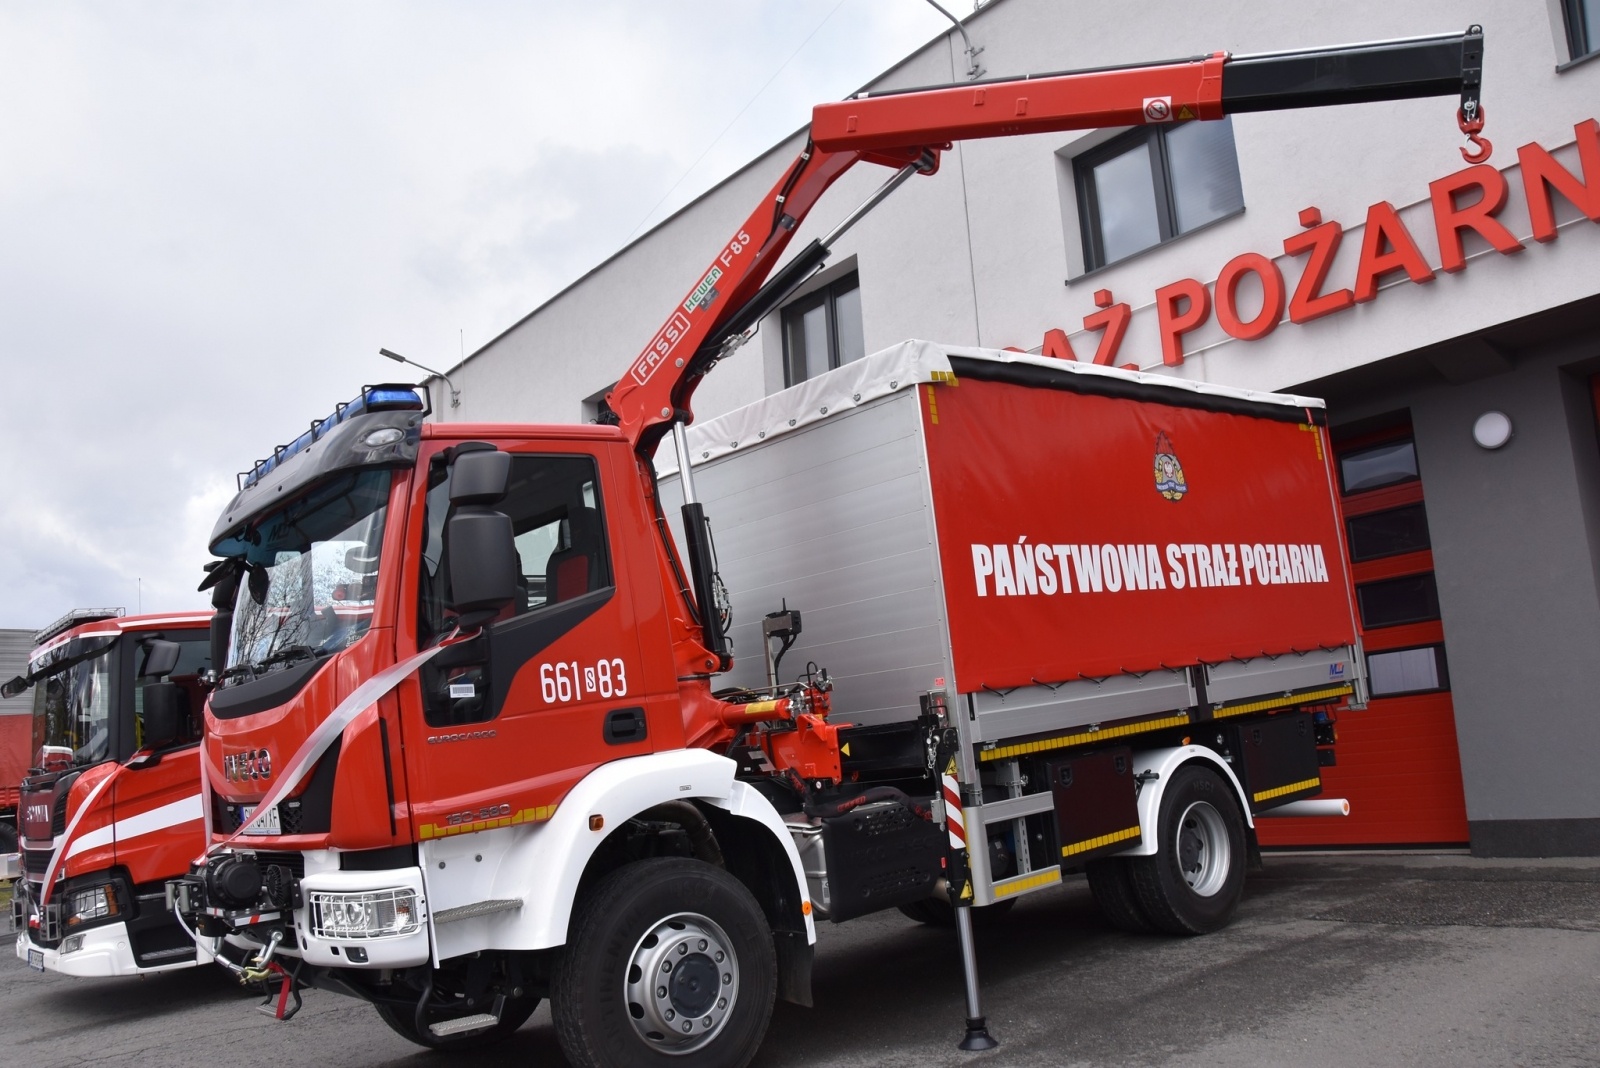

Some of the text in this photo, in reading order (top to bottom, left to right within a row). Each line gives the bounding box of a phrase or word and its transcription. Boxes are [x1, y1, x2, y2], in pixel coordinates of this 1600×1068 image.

[637, 320, 684, 378] FASSI
[685, 268, 721, 311] HEWEA
[971, 535, 1329, 597] PAŃSTWOWA STRAŻ POŻARNA
[427, 729, 497, 744] EUROCARGO
[224, 748, 271, 783] IVECO
